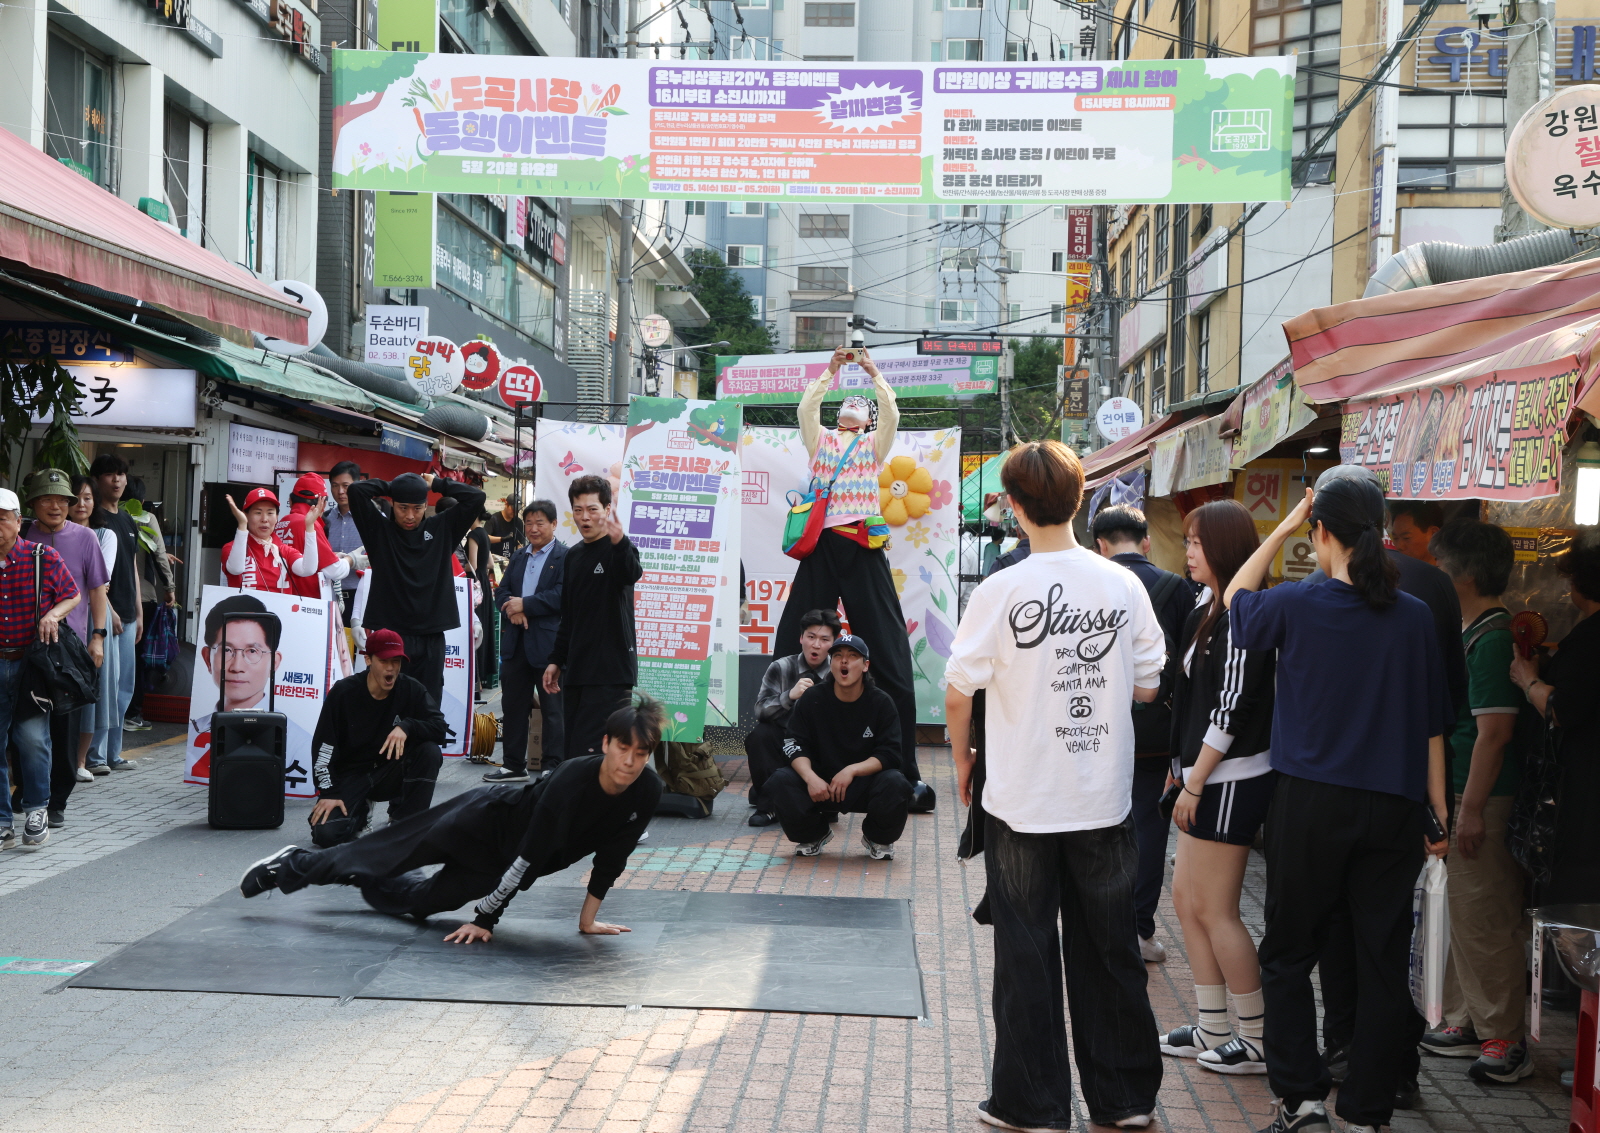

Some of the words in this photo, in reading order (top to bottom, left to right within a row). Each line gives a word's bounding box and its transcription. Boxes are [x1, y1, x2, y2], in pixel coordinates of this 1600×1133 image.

[772, 72, 840, 87] 증정이벤트
[938, 71, 1011, 90] 1만원이상
[1016, 71, 1098, 89] 구매영수증
[1106, 70, 1139, 88] 제시
[1144, 70, 1178, 88] 참여
[450, 76, 582, 114] 도곡시장
[655, 88, 712, 104] 16시부터
[714, 89, 786, 105] 소진시까지!
[830, 95, 902, 120] 날짜변경
[1081, 98, 1122, 108] 15시부터
[1124, 97, 1170, 108] 18시까지!
[654, 112, 690, 122] 도곡시장
[692, 112, 708, 122] 구매
[758, 114, 776, 124] 고객
[944, 109, 976, 118] 이벤트1.
[944, 120, 956, 132] 다
[959, 119, 982, 132] 함께
[1047, 119, 1082, 132] 이벤트
[424, 112, 608, 156] 동행이벤트
[944, 136, 978, 145] 이벤트2.
[1225, 135, 1256, 144] 도곡시장
[943, 148, 978, 161] 캐릭터
[982, 148, 1016, 160] 솜사탕
[1020, 148, 1042, 160] 증정
[1054, 148, 1088, 160] 어린이
[1092, 148, 1116, 160] 무료
[462, 160, 483, 174] 5월
[486, 161, 518, 176] 20일
[521, 162, 558, 177] 화요일
[943, 164, 977, 172] 이벤트3.
[942, 175, 966, 187] 경품
[969, 175, 992, 187] 풍선
[996, 175, 1042, 187] 터트리기
[1074, 217, 1087, 254] 인테리어
[382, 274, 423, 282] T.566-3374
[370, 316, 420, 332] 두손바디
[416, 340, 455, 363] 대박
[948, 341, 976, 351] 단속이
[409, 356, 431, 379] 닭
[732, 370, 758, 378] 도곡시장
[760, 368, 786, 378] 이용고객
[788, 368, 801, 376] 대상
[417, 373, 452, 396] 강정
[505, 372, 534, 402] 떡
[728, 381, 758, 392] 주차요금
[760, 380, 776, 390] 최대
[778, 380, 798, 390] 2시간
[958, 380, 986, 390] 도곡시장
[1112, 400, 1122, 410] 쌀
[1102, 412, 1136, 425] 건어물
[1109, 426, 1131, 438] 식품
[1353, 400, 1404, 465] 순천집
[1458, 380, 1517, 489] 김치전문
[649, 455, 711, 474] 도곡시장
[634, 470, 722, 493] 동행이벤트
[680, 494, 698, 502] 화요일
[1246, 473, 1278, 514] 햇
[634, 505, 710, 522] 온누리상품권
[656, 520, 688, 534] 20%
[674, 539, 696, 551] 날짜
[698, 540, 720, 552] 변경
[644, 552, 676, 561] 05.14(수)
[683, 555, 706, 563] 05.20
[1058, 662, 1100, 676] COMPTON
[282, 671, 313, 685] 새롭게
[1051, 679, 1082, 692] SANTA
[1085, 676, 1107, 689] ANA
[274, 685, 318, 700] 대한민국!
[1056, 722, 1109, 739] BROOKLYN
